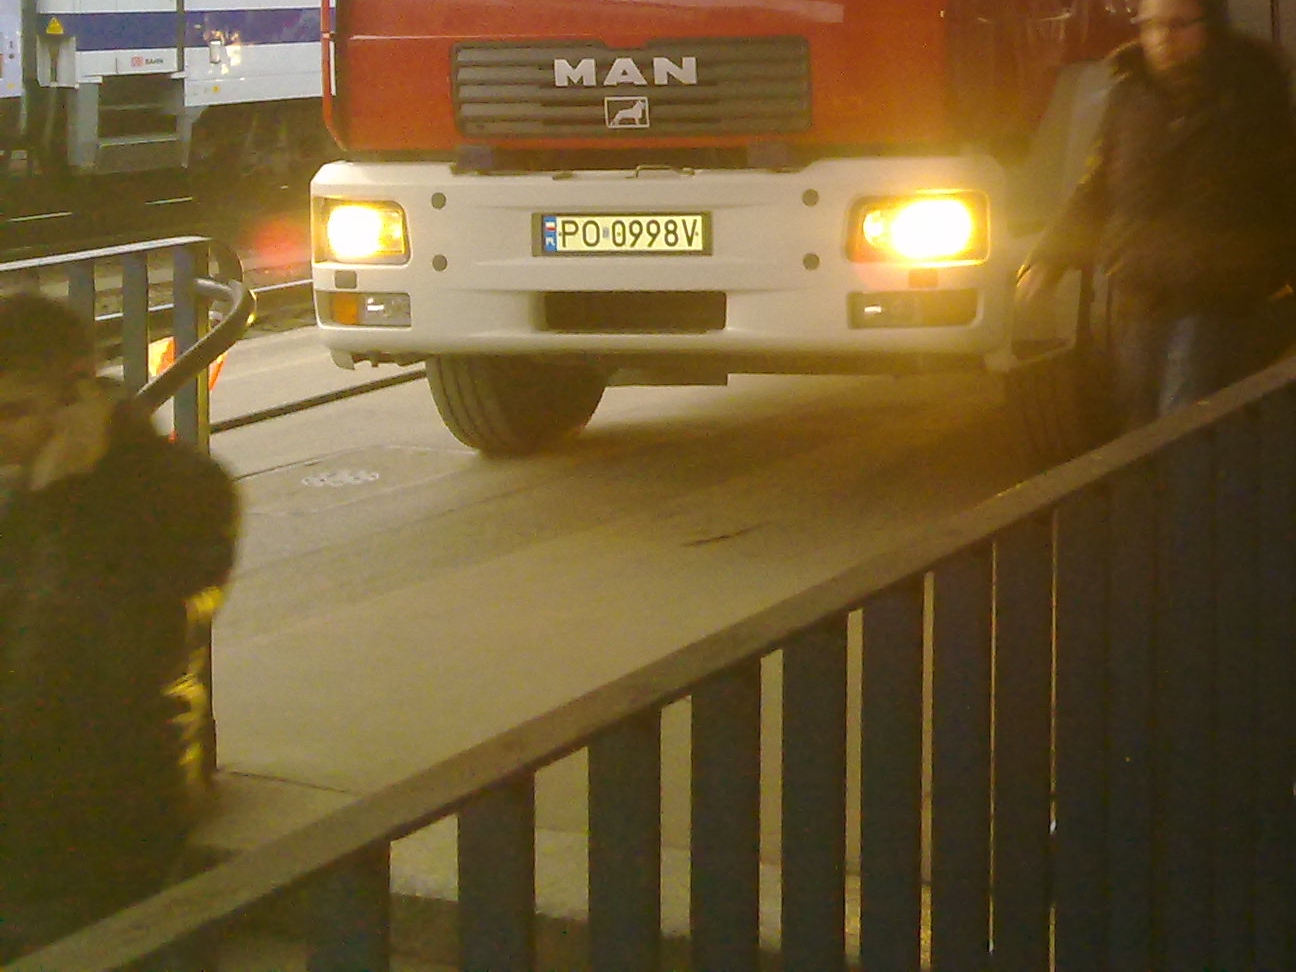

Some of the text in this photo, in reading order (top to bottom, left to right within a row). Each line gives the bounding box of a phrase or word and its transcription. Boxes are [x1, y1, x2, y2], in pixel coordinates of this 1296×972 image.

[553, 56, 698, 88] MAN
[561, 218, 698, 248] PO 0998V
